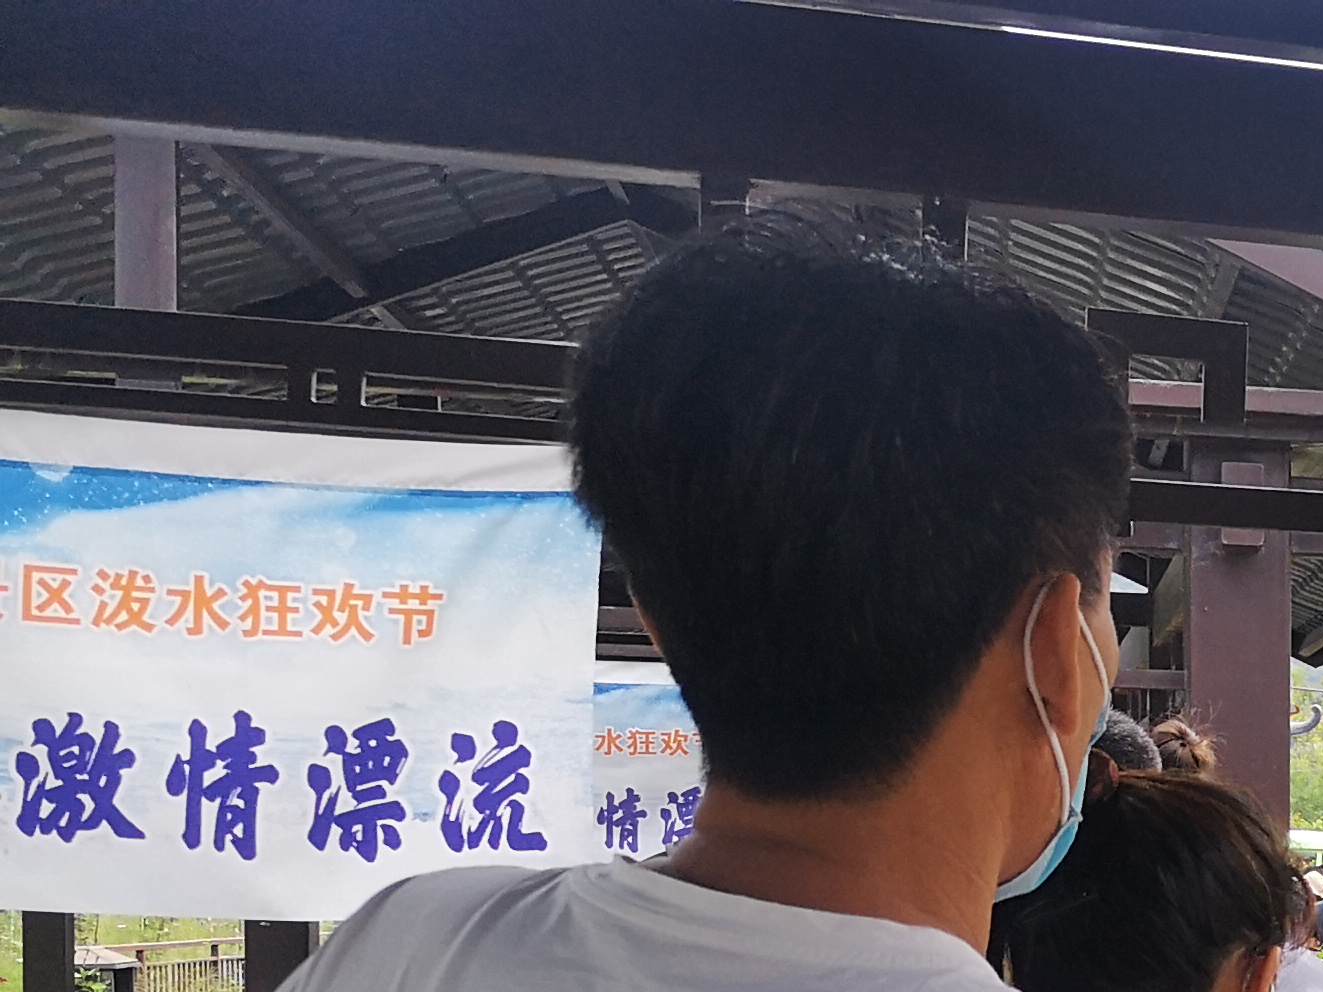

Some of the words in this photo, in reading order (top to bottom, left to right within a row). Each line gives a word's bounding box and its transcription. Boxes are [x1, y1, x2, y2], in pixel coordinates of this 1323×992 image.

[0, 564, 445, 648] 区泼水狂欢节
[15, 709, 548, 863] 激情漂流
